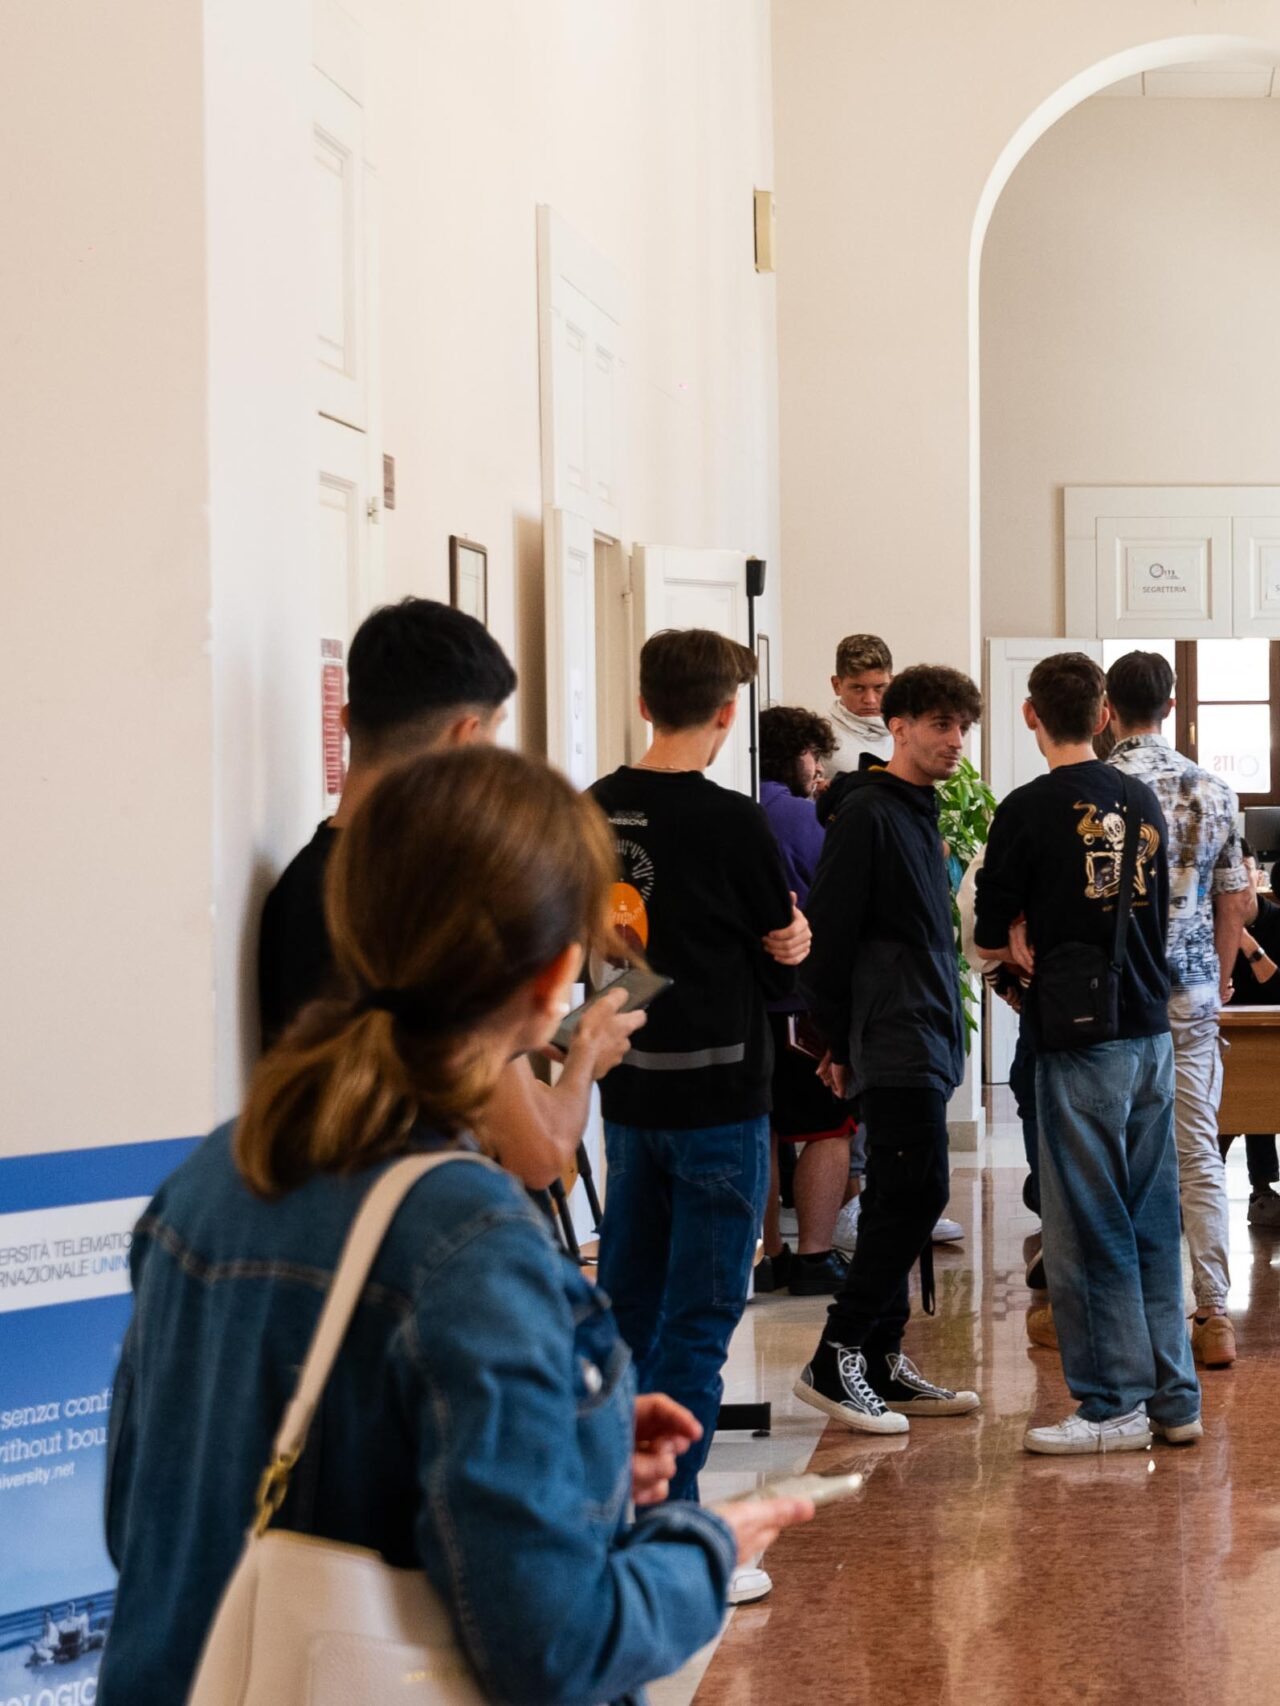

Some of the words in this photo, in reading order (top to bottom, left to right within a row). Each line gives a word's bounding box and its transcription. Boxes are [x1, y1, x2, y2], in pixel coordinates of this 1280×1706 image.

[1142, 585, 1187, 593] SEGRETERIA
[1, 1402, 60, 1430] senza
[64, 1388, 114, 1418] conf
